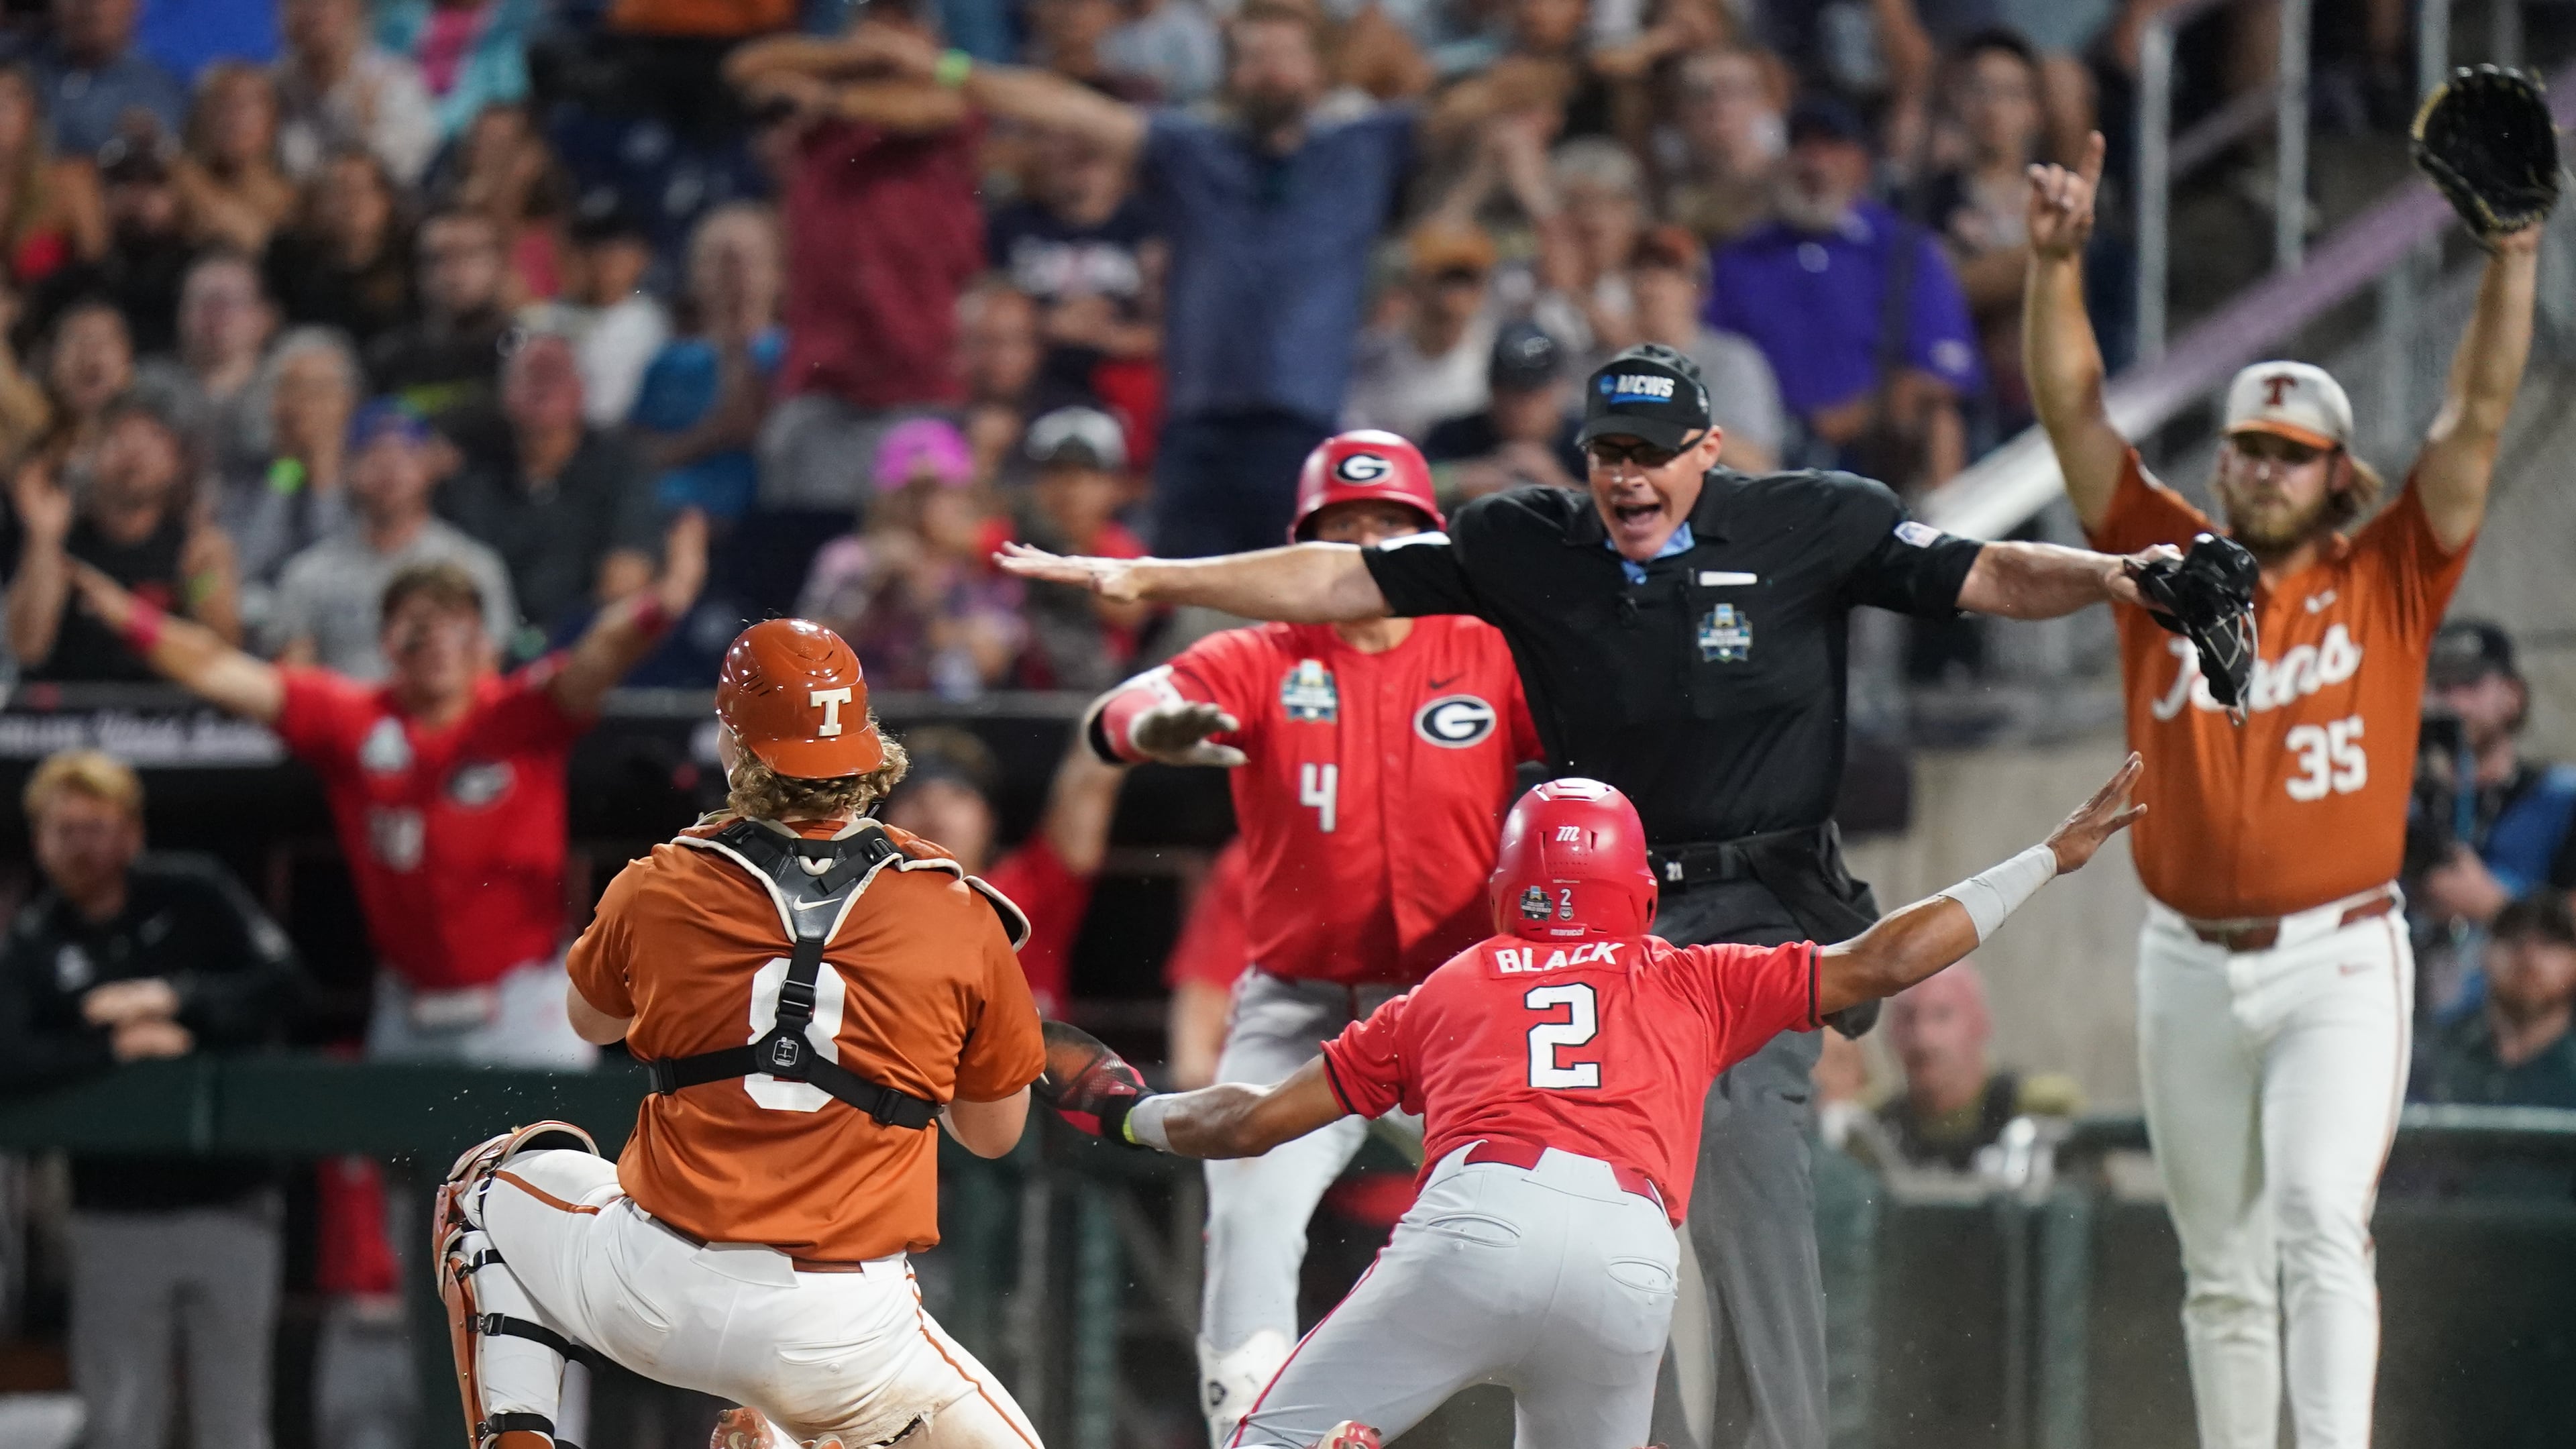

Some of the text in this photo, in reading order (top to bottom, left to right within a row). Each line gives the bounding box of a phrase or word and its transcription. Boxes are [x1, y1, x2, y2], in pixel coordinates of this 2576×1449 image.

[1615, 374, 1675, 398] MCWS
[2260, 373, 2298, 407] T
[1339, 453, 1391, 481] G
[810, 686, 852, 737] T
[1421, 700, 1495, 742] G
[2285, 714, 2368, 802] 35
[1299, 762, 1338, 833] 4
[1556, 826, 1580, 842] m
[1560, 888, 1572, 906] 2
[1495, 941, 1626, 973] BLACK
[743, 957, 847, 1113] 8
[1523, 981, 1602, 1089] 2
